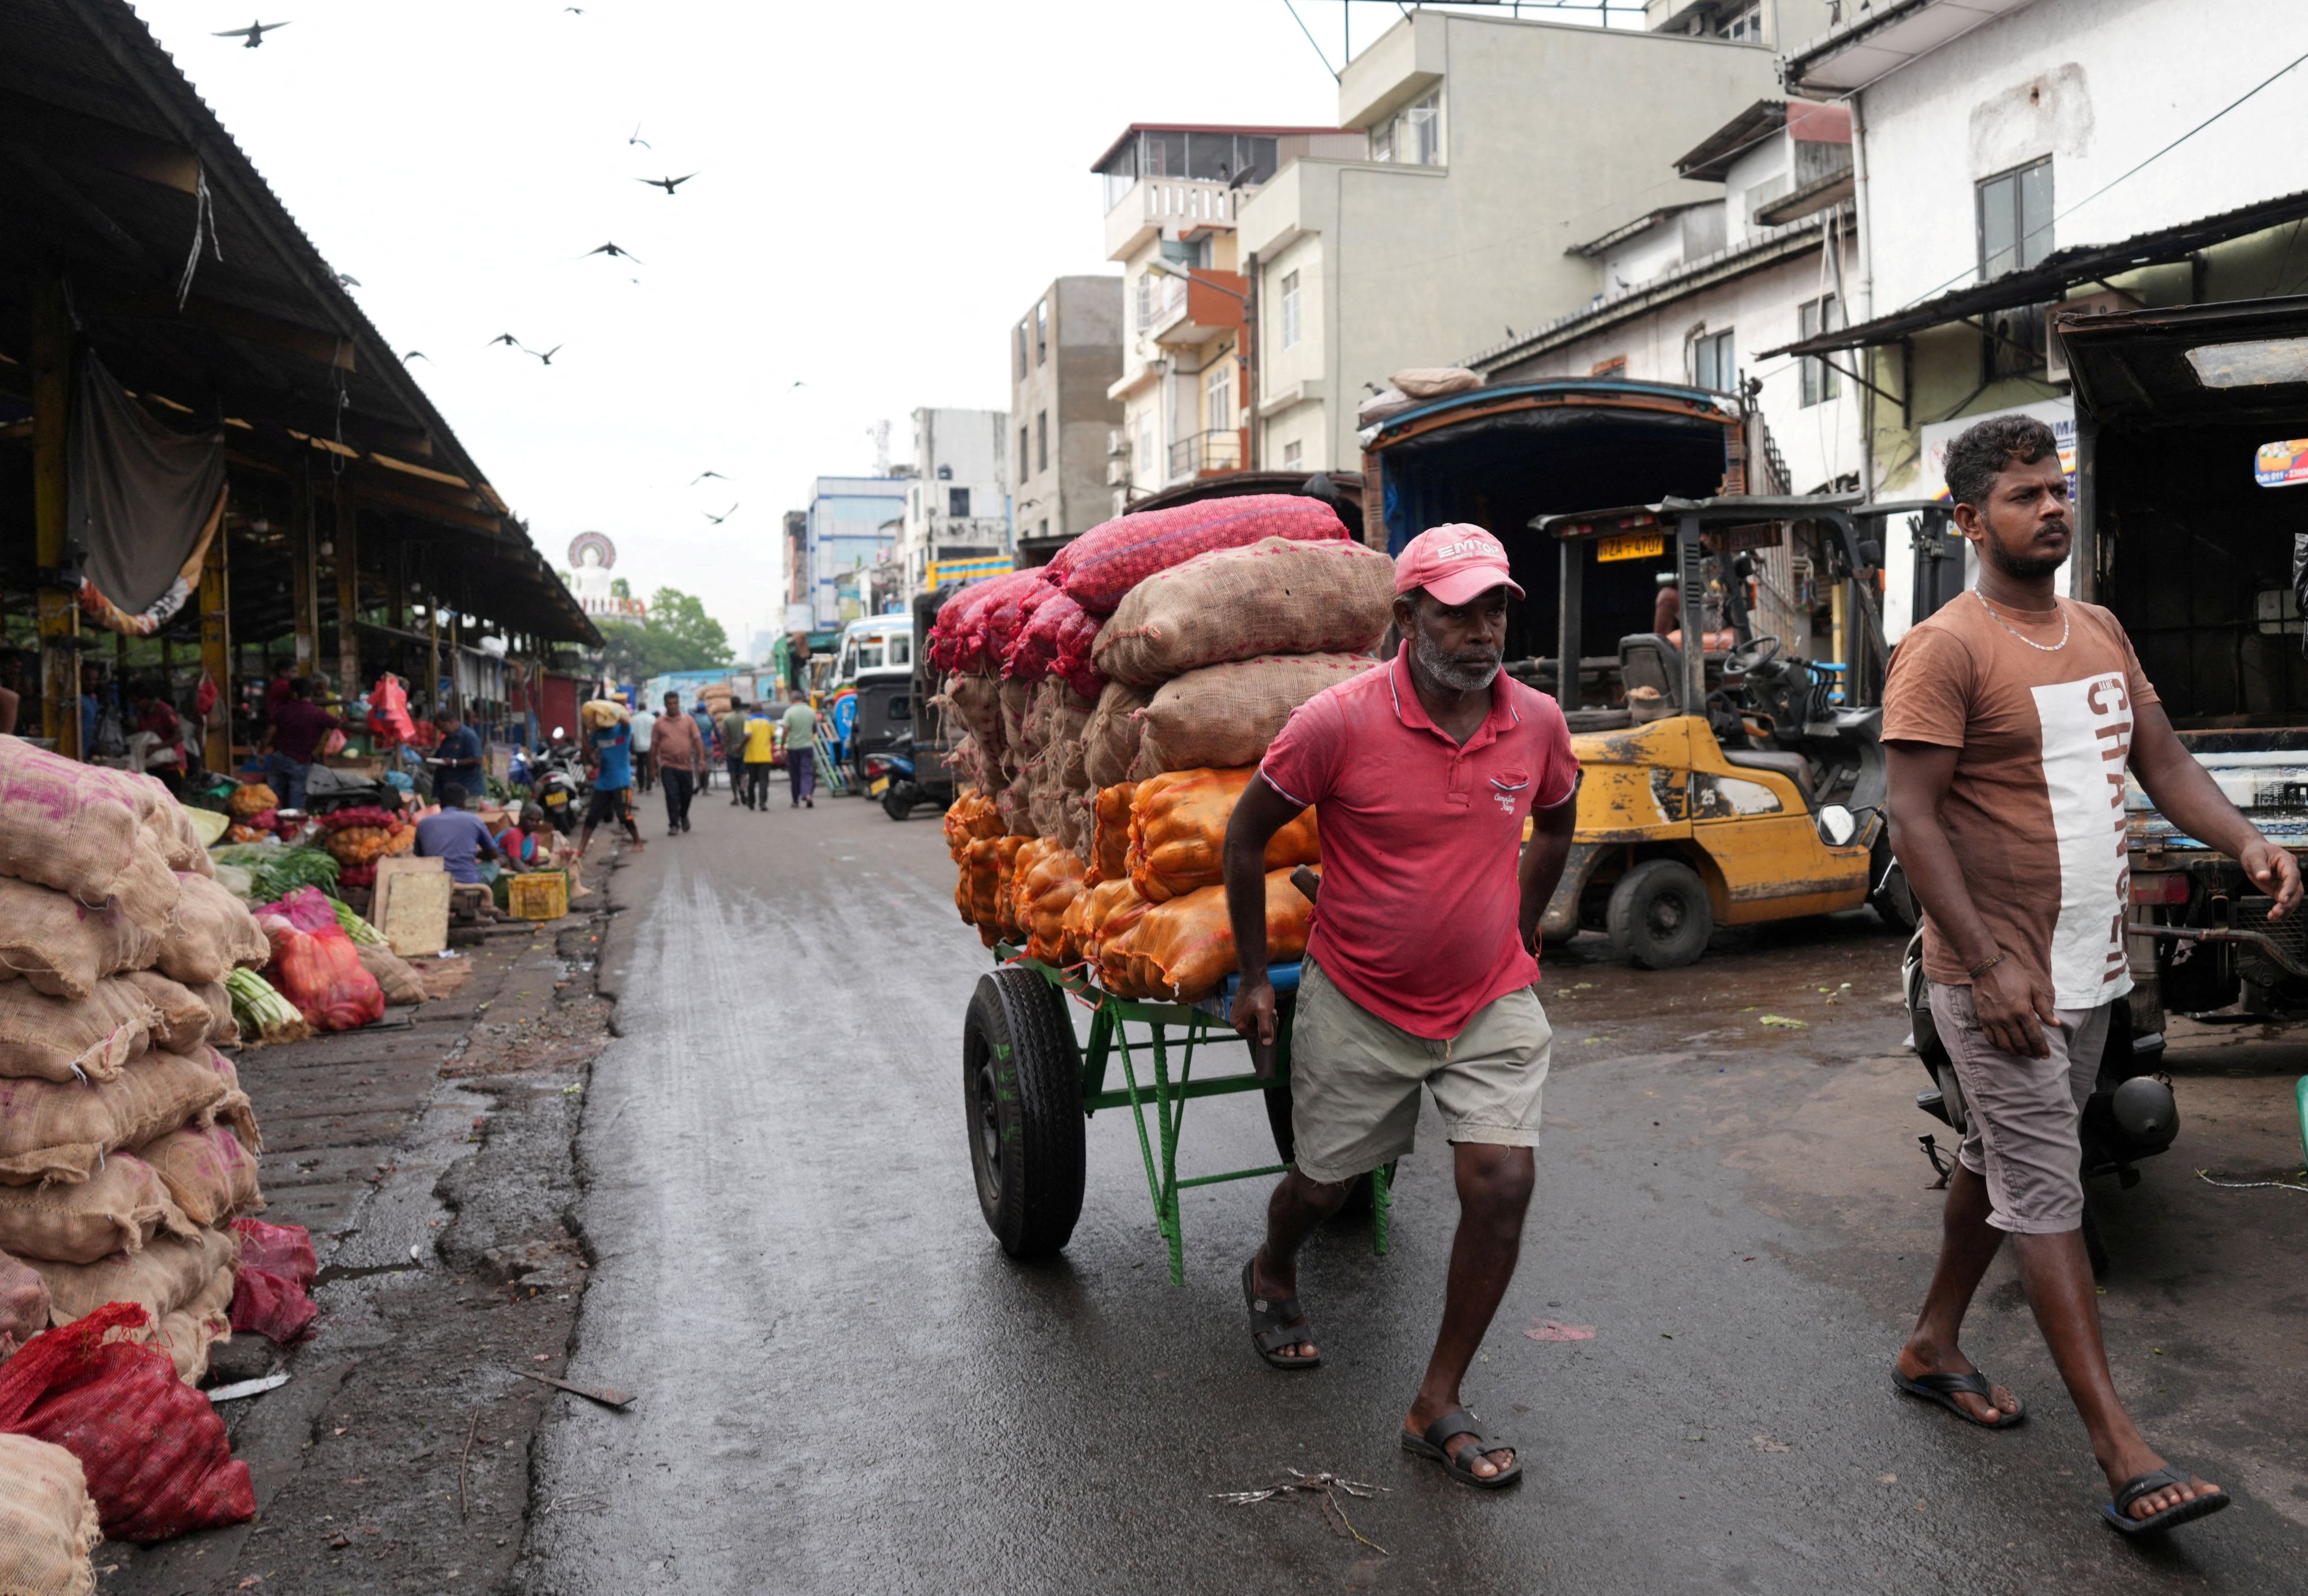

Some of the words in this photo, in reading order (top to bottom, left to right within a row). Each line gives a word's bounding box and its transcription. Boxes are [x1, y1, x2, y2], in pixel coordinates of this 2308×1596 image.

[1437, 540, 1500, 559] EMTOP
[2098, 679, 2115, 691] GAME
[1701, 789, 1716, 805] 25
